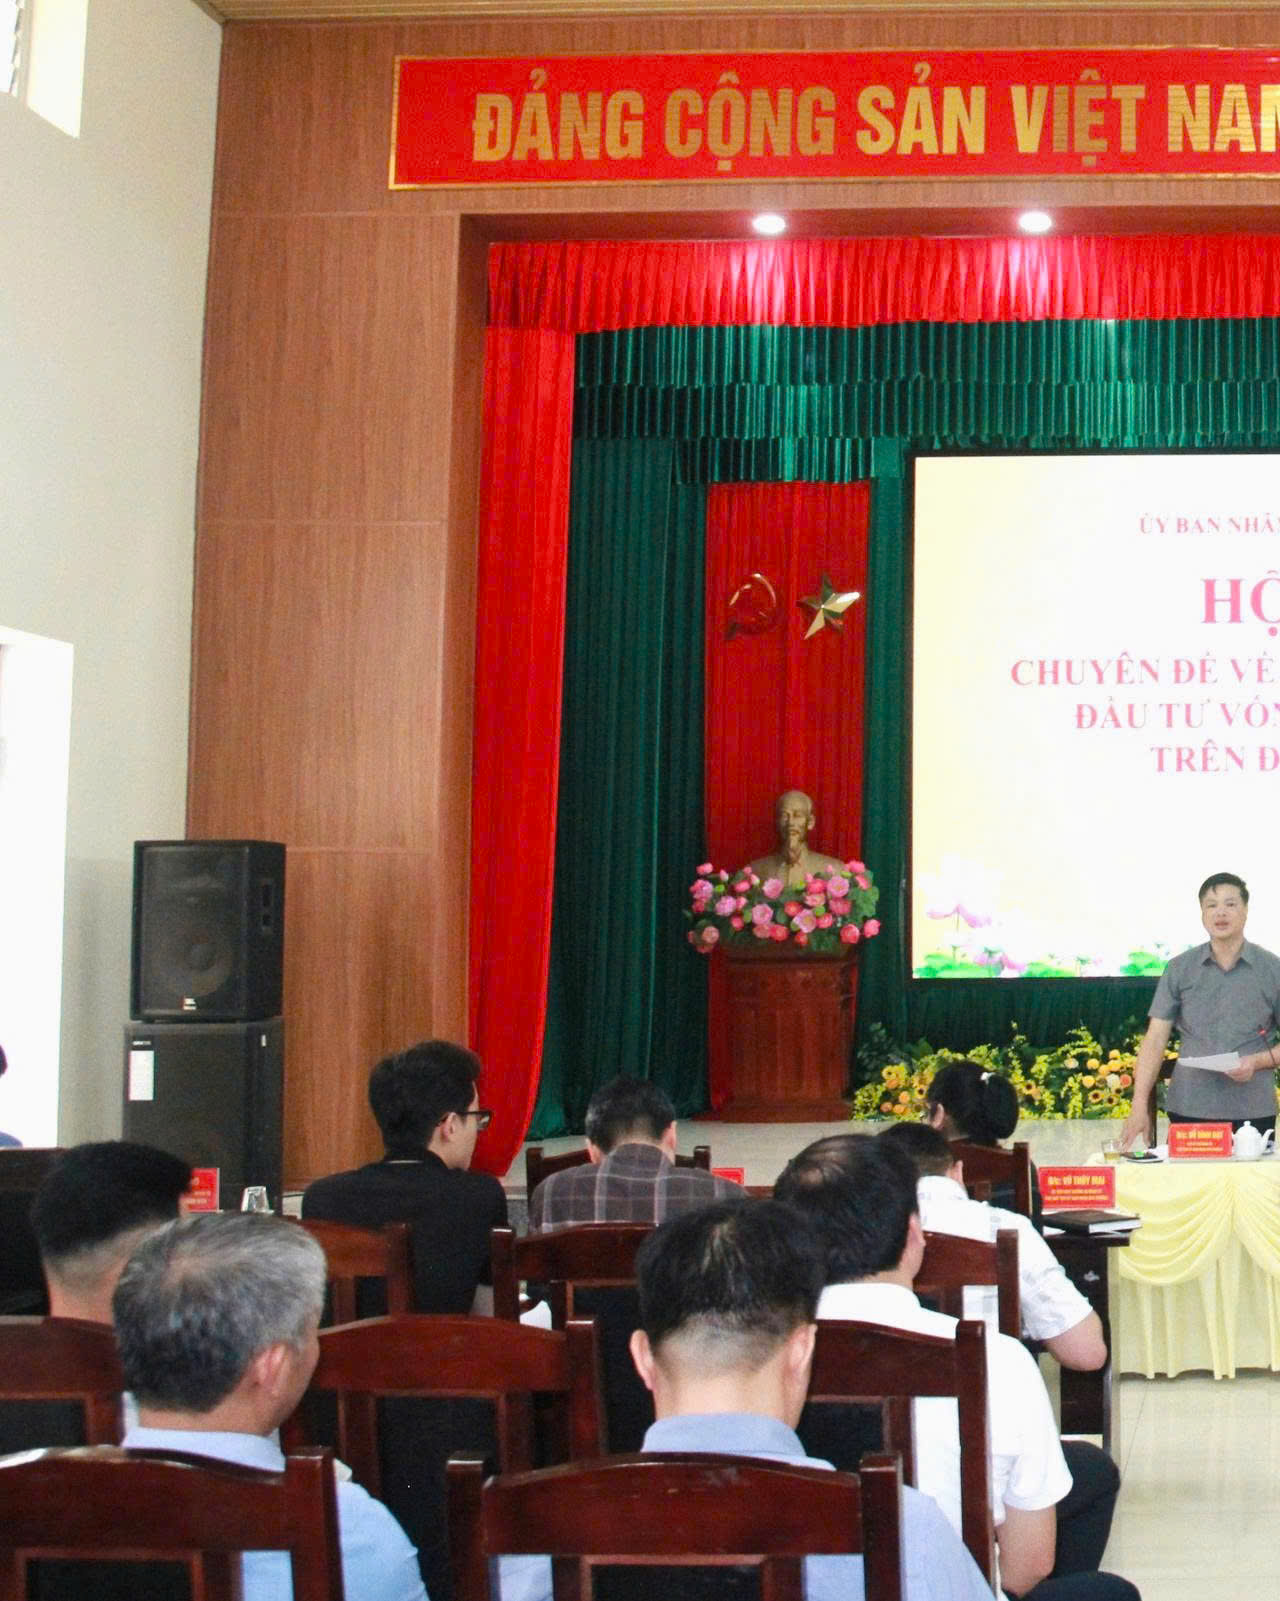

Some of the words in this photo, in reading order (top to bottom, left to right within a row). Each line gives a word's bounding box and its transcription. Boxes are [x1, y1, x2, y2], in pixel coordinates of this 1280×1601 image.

[472, 68, 646, 163] ĐẢNG
[665, 70, 837, 171] CỘNG
[856, 61, 986, 156] SẢN
[1010, 68, 1146, 167] VIỆT
[1176, 516, 1221, 534] BAN
[1010, 651, 1160, 686] CHUYÊN
[1158, 697, 1211, 728] TƯ
[1150, 738, 1246, 773] TRÊN
